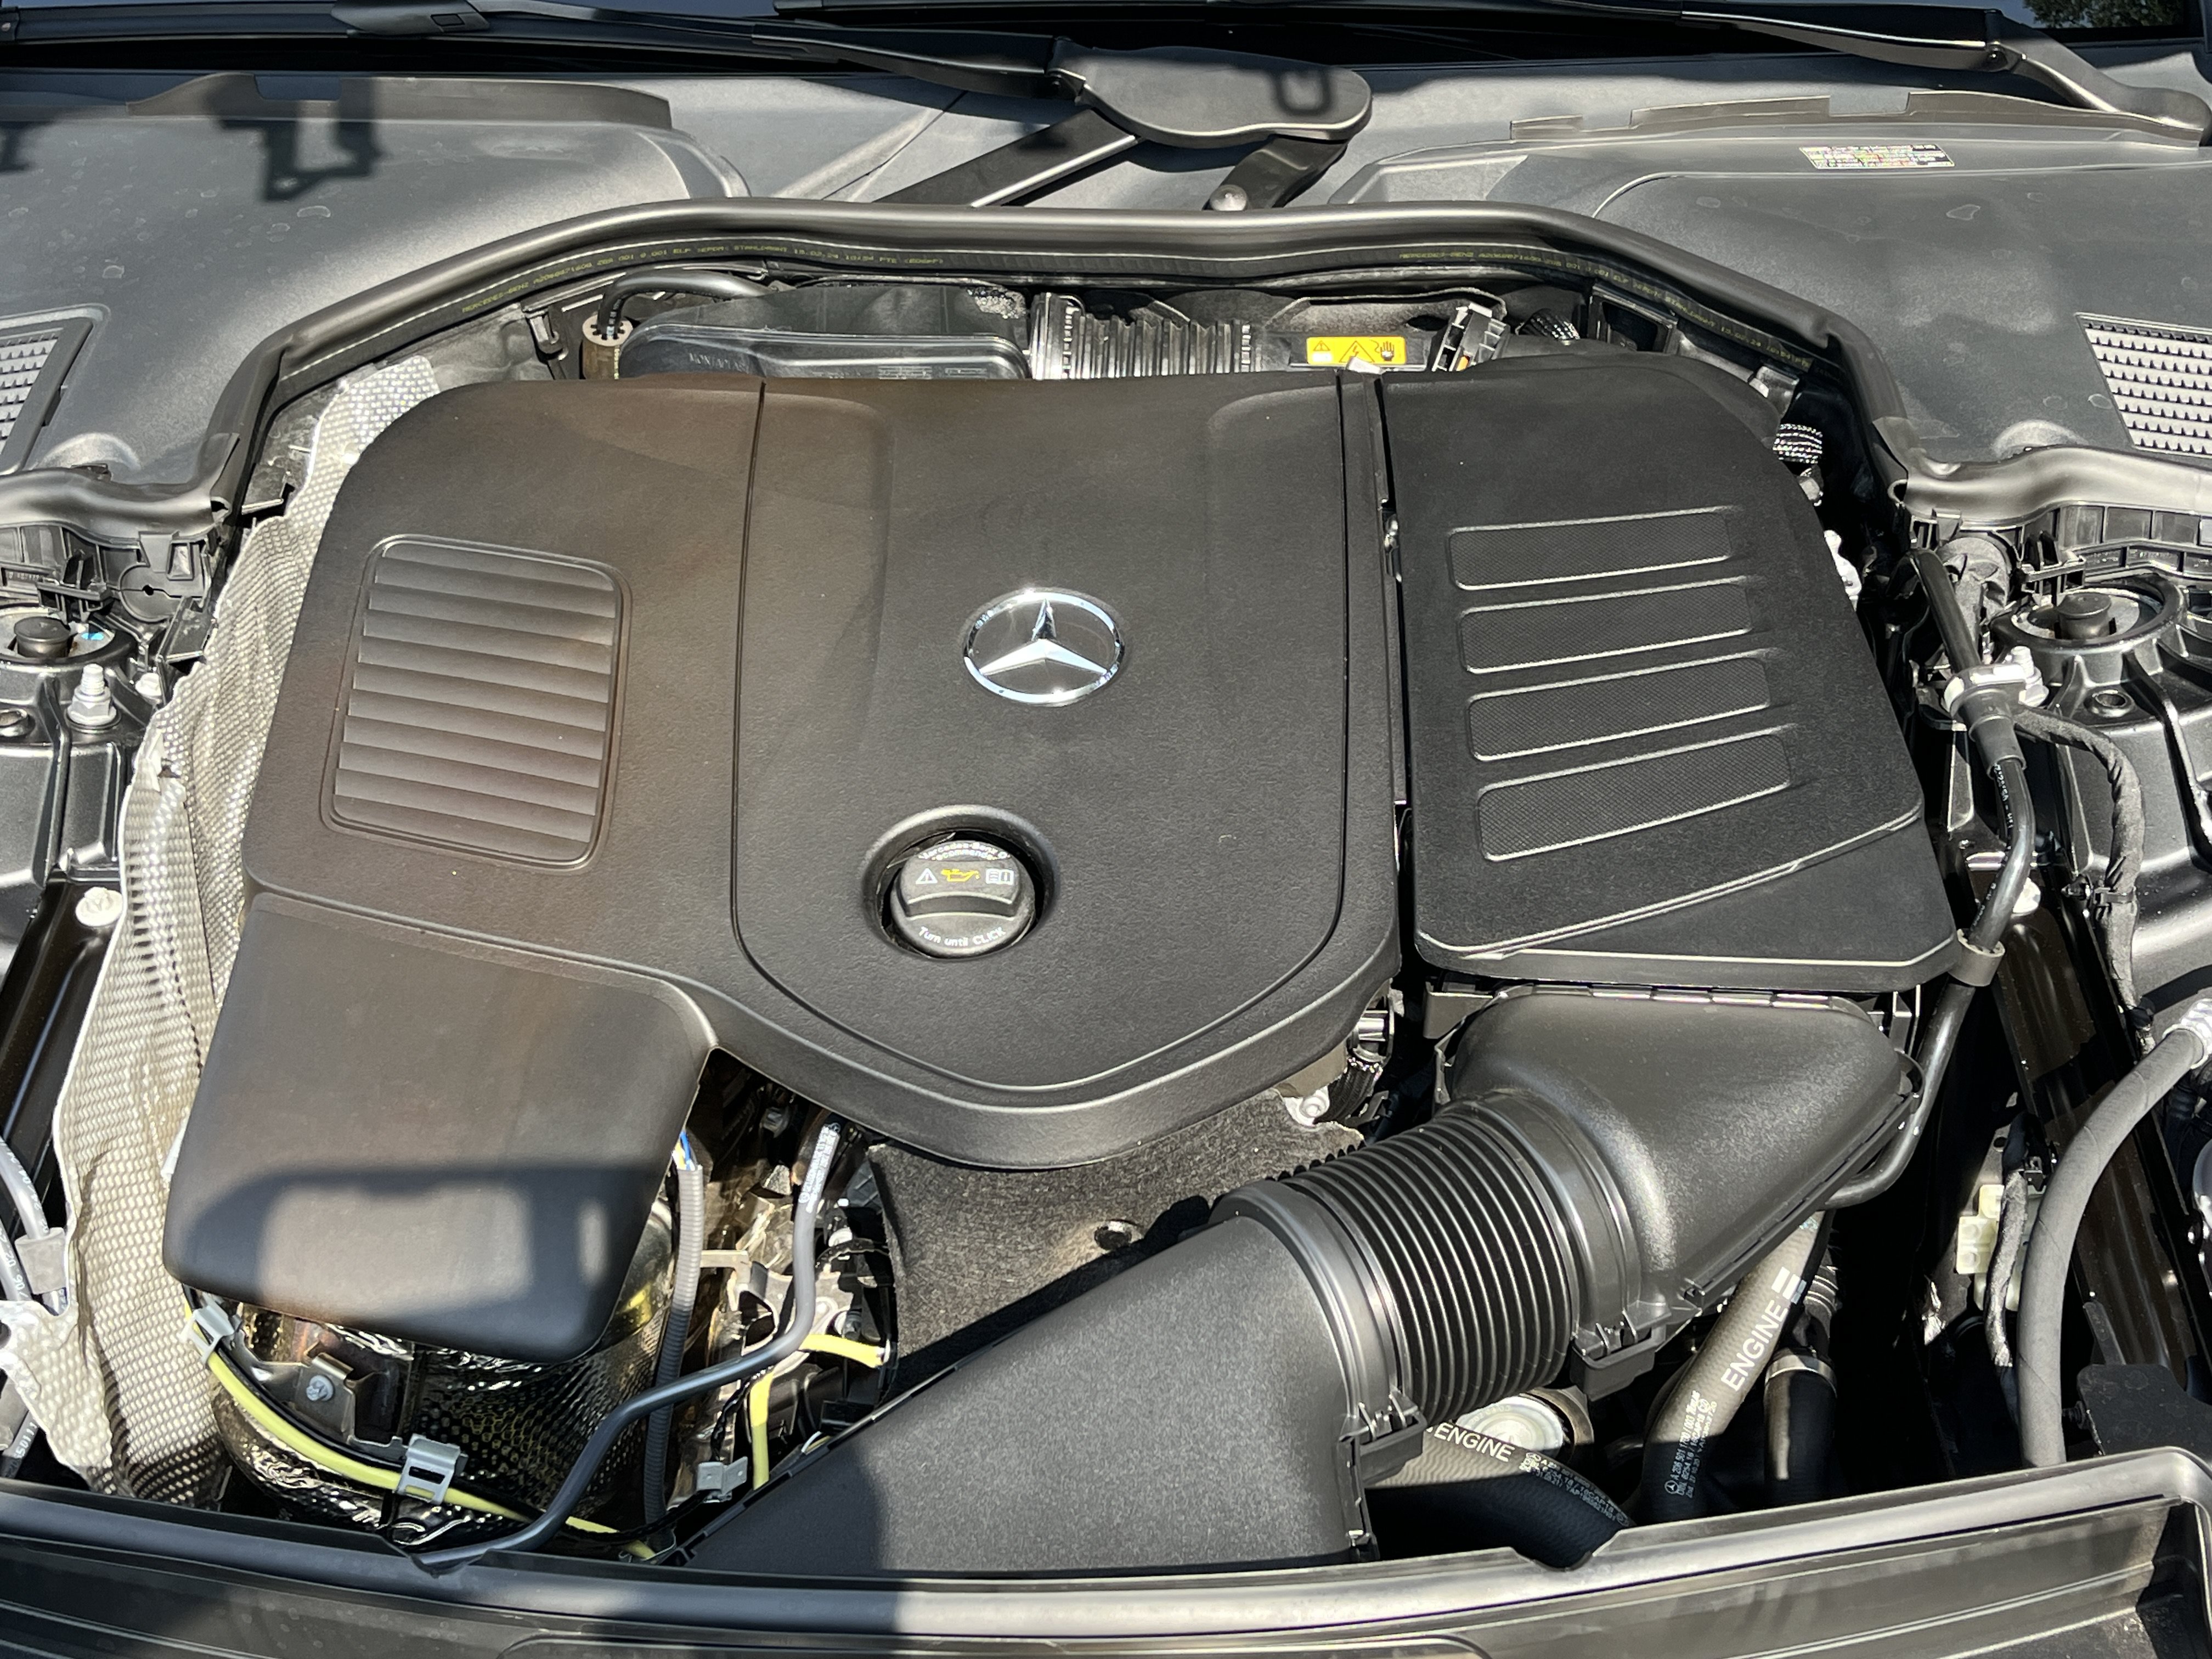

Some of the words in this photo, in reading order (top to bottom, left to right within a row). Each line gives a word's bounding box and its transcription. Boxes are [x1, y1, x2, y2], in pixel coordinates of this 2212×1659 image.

[919, 926, 941, 943] Turn
[944, 937, 968, 946] until
[972, 927, 1006, 945] CLICK
[1720, 1299, 1788, 1392] ENGINE
[1434, 1422, 1515, 1462] ENGINE
